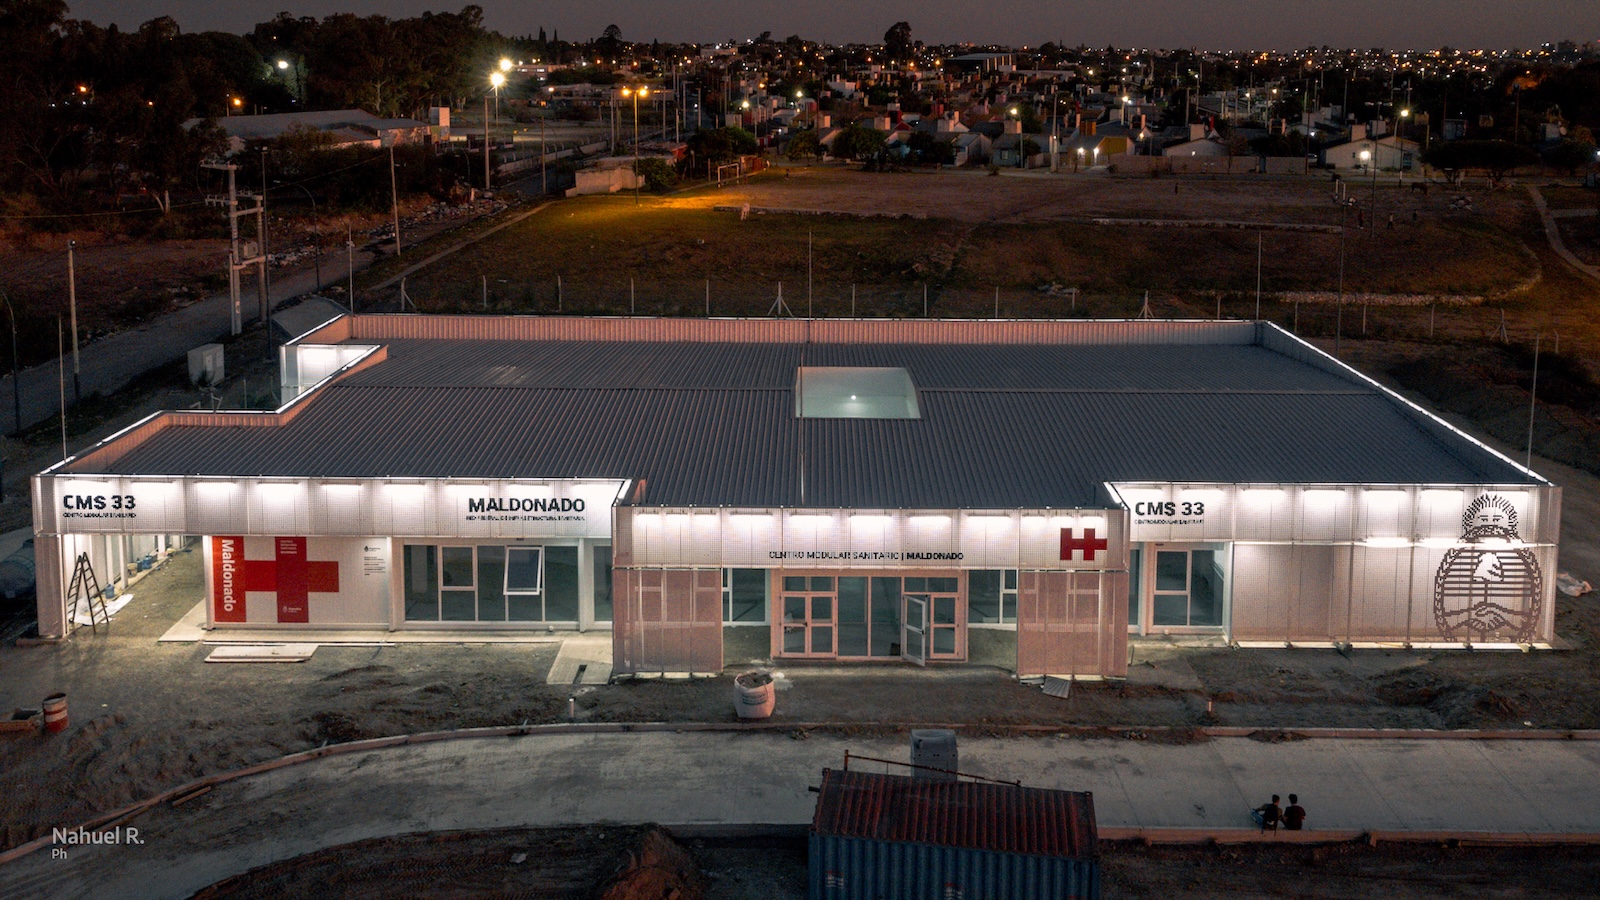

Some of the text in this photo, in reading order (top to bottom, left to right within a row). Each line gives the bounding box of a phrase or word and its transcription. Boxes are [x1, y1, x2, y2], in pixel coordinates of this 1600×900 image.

[63, 495, 136, 510] CMS 33
[469, 498, 585, 512] MALDONADO
[1135, 502, 1205, 516] CMS 33
[769, 551, 804, 559] CENTRO
[853, 552, 899, 560] SANITARIO
[906, 552, 964, 560] MALDONADO
[221, 539, 237, 612] Maldonado
